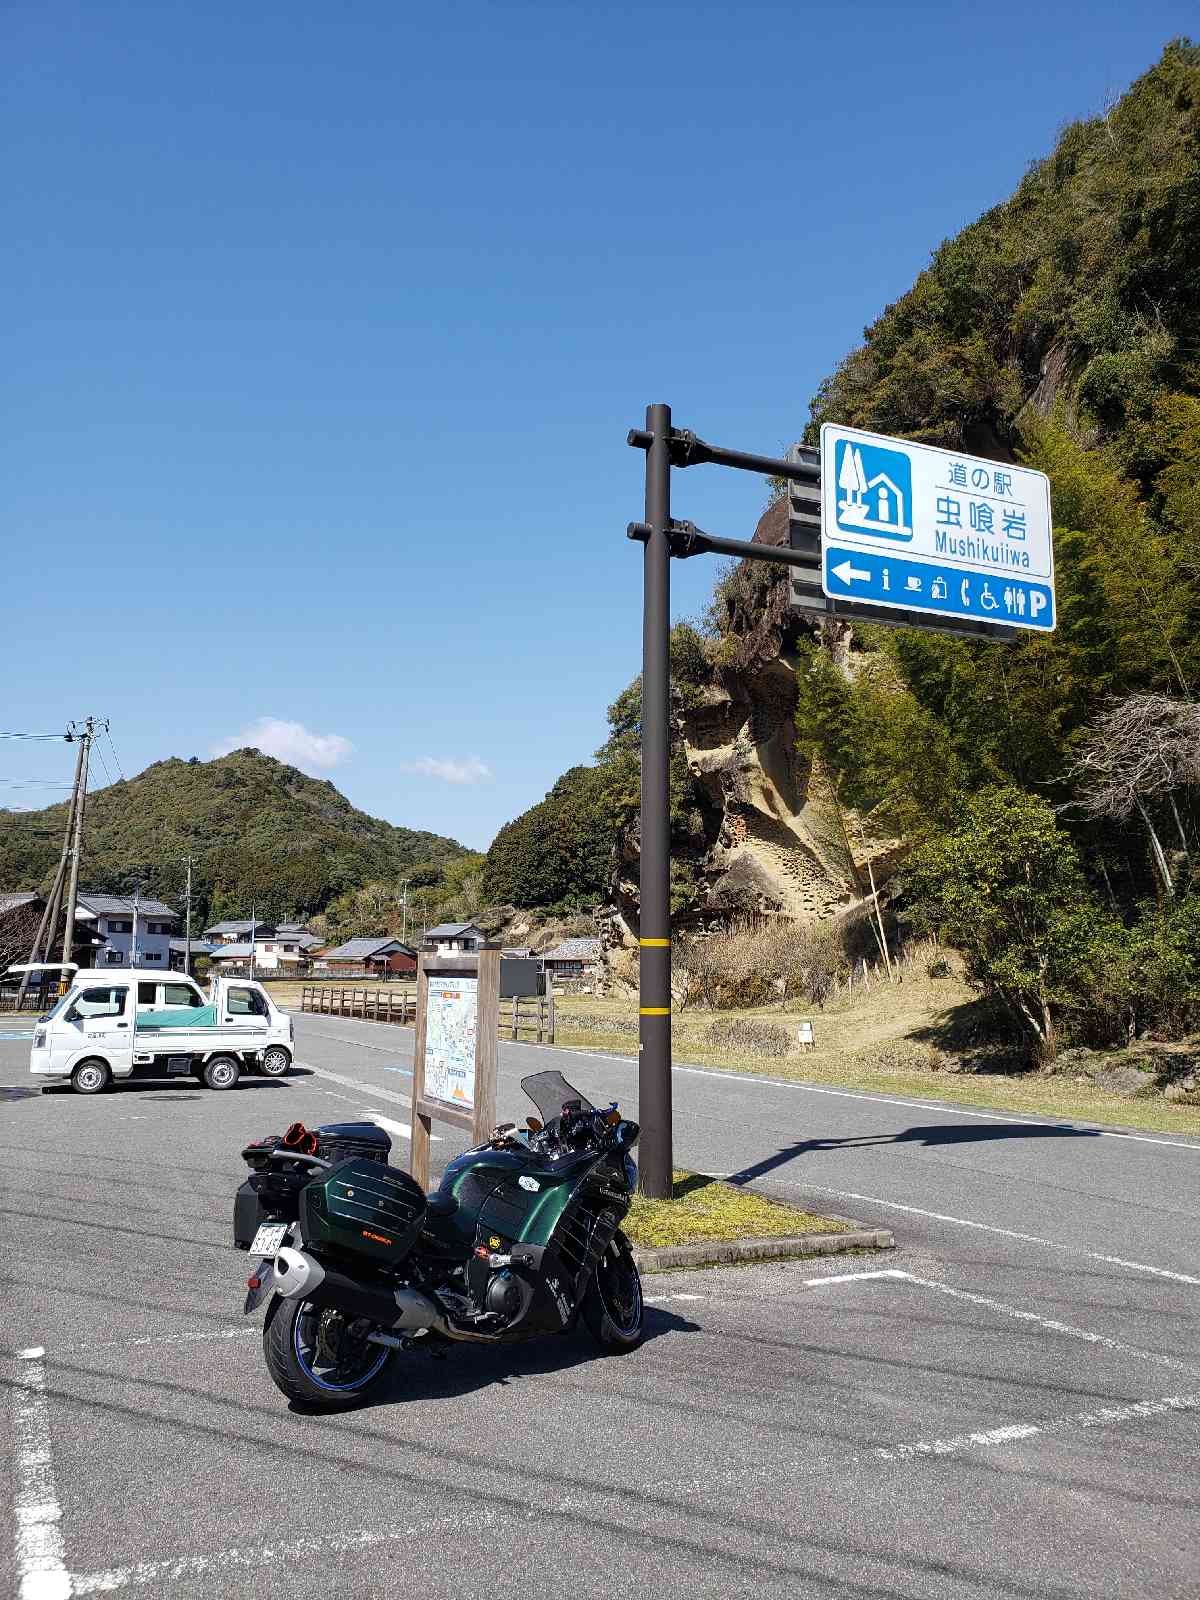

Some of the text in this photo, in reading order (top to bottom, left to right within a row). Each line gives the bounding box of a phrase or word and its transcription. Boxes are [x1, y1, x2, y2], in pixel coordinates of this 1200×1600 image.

[948, 462, 1013, 496] 道の駅
[936, 496, 1027, 541] 虫喰岩
[935, 529, 1030, 568] Mushikuiiwa
[1029, 590, 1047, 618] P
